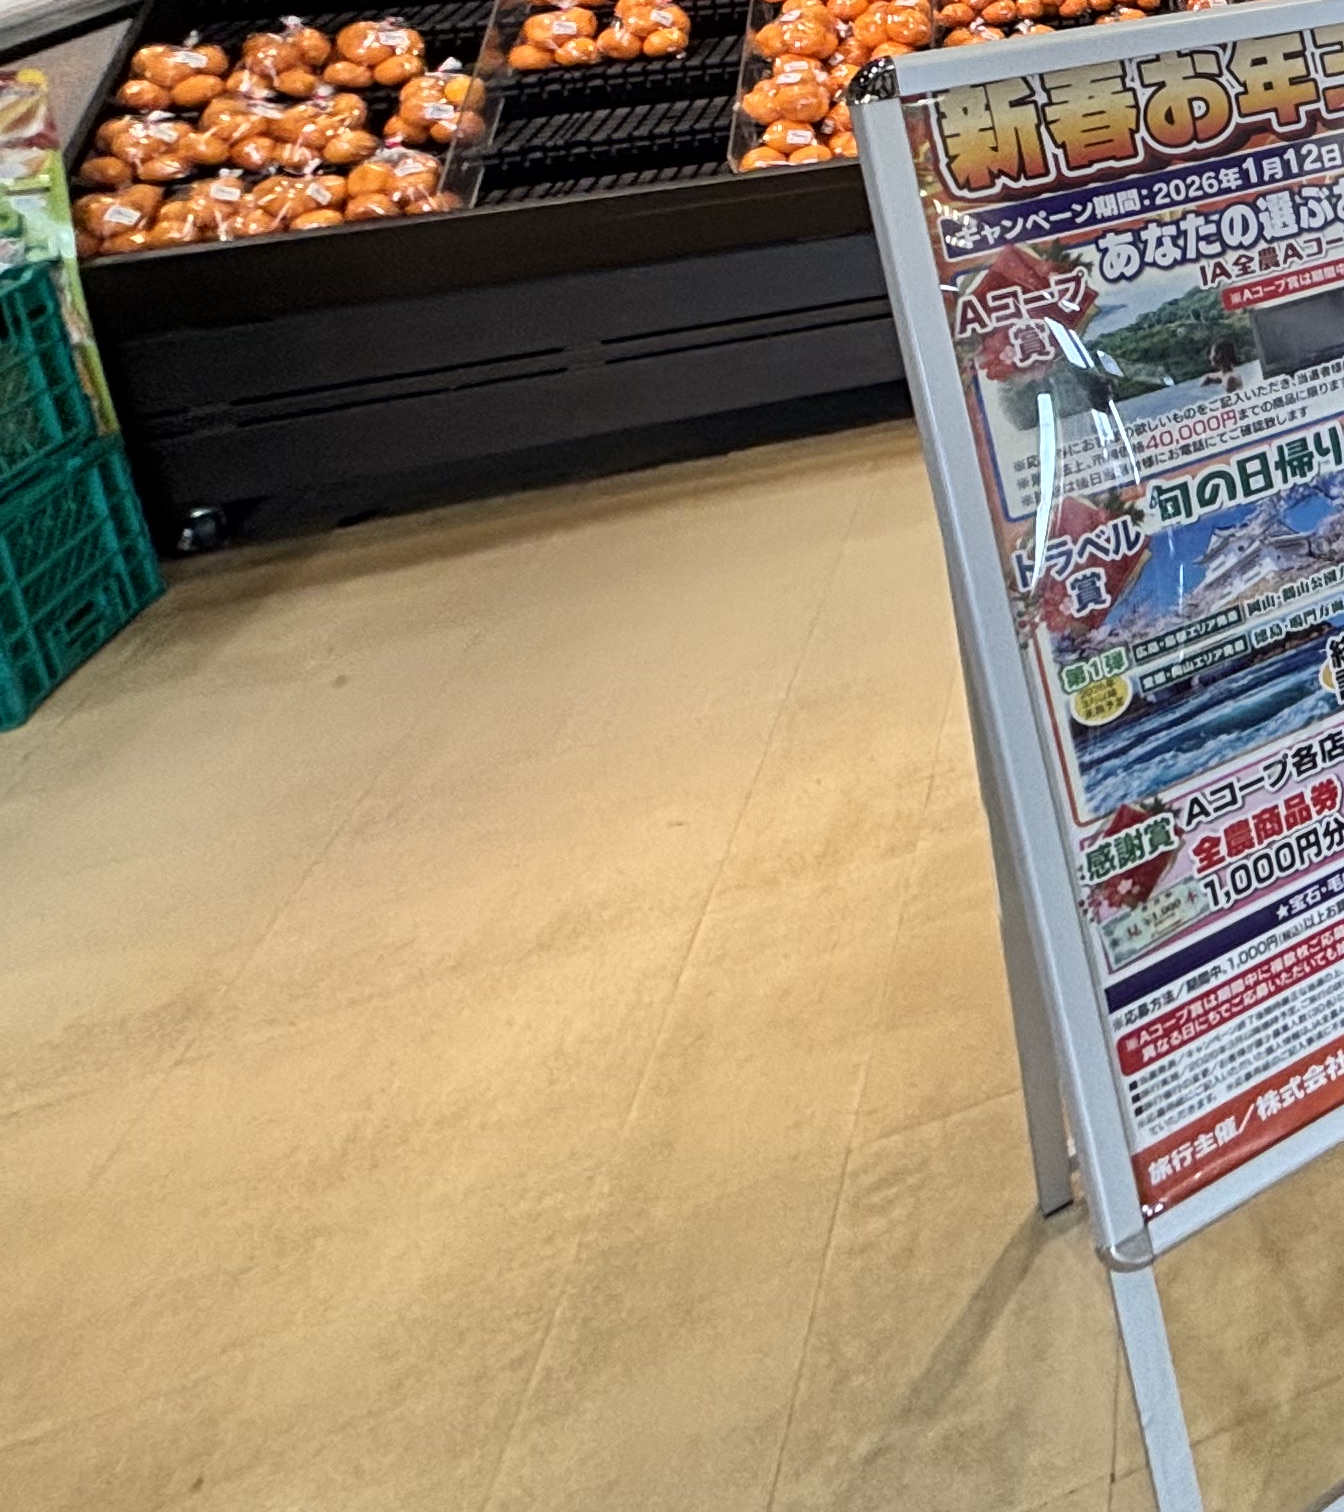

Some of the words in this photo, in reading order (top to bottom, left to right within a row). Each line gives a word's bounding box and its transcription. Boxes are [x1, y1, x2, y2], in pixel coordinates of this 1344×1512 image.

[952, 266, 1093, 338] Aコープ
[1008, 320, 1052, 363] 賞
[1012, 511, 1145, 591] トラベル
[1067, 567, 1109, 616] 賞
[1083, 811, 1177, 884] 感謝賞
[1189, 775, 1342, 875] 全農商品券
